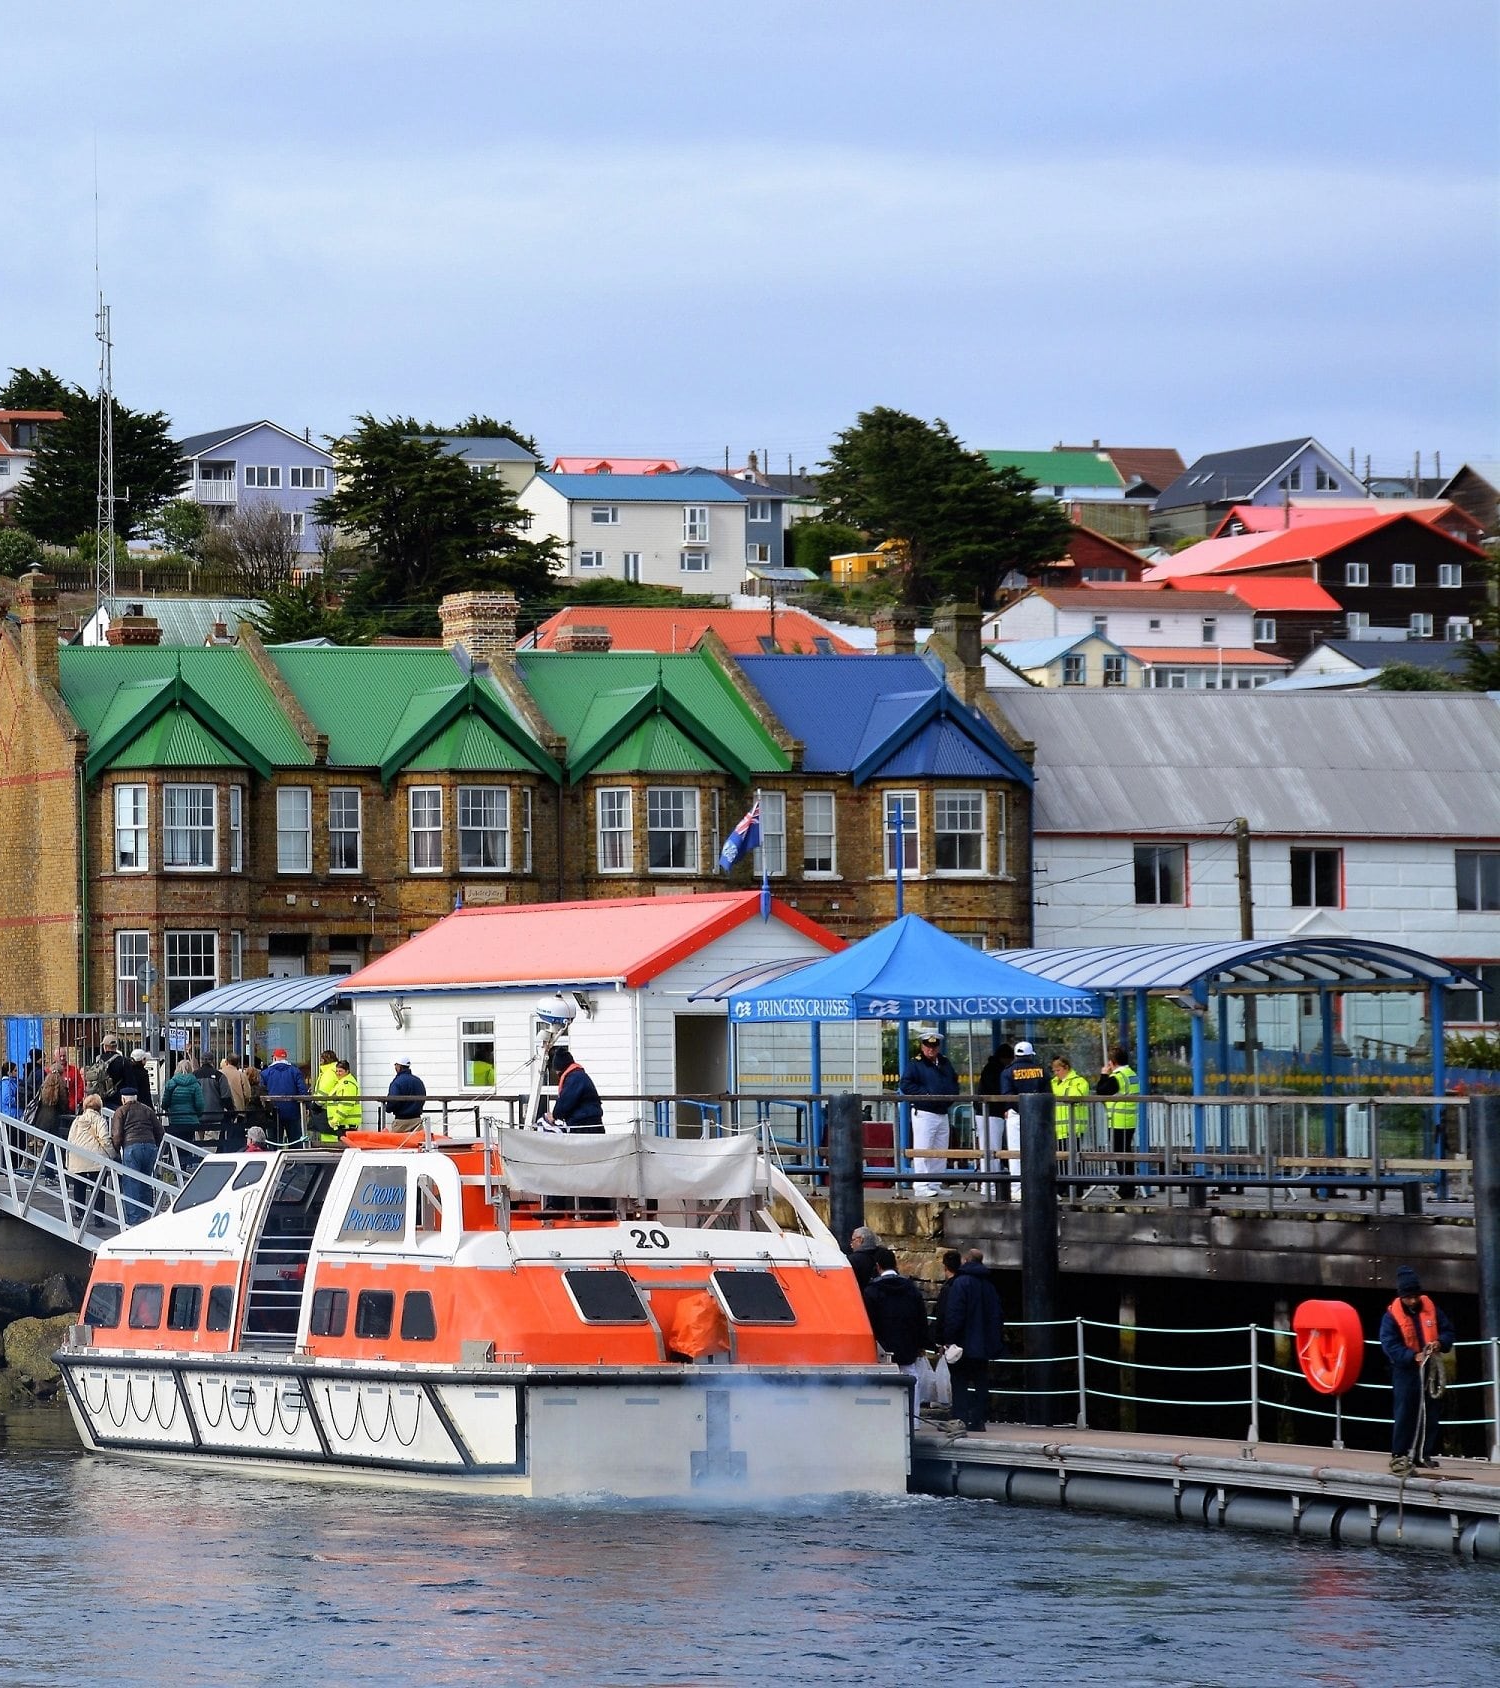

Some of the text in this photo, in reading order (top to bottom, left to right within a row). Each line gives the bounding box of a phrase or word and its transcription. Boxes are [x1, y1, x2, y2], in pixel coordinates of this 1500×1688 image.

[756, 999, 850, 1017] PRINCESS CRUISES
[913, 997, 1093, 1016] PRINCESS CRUISES
[1013, 1068, 1044, 1080] SECURITY
[207, 1212, 230, 1239] 20
[344, 1210, 404, 1232] PRINCESS
[629, 1229, 670, 1249] 20
